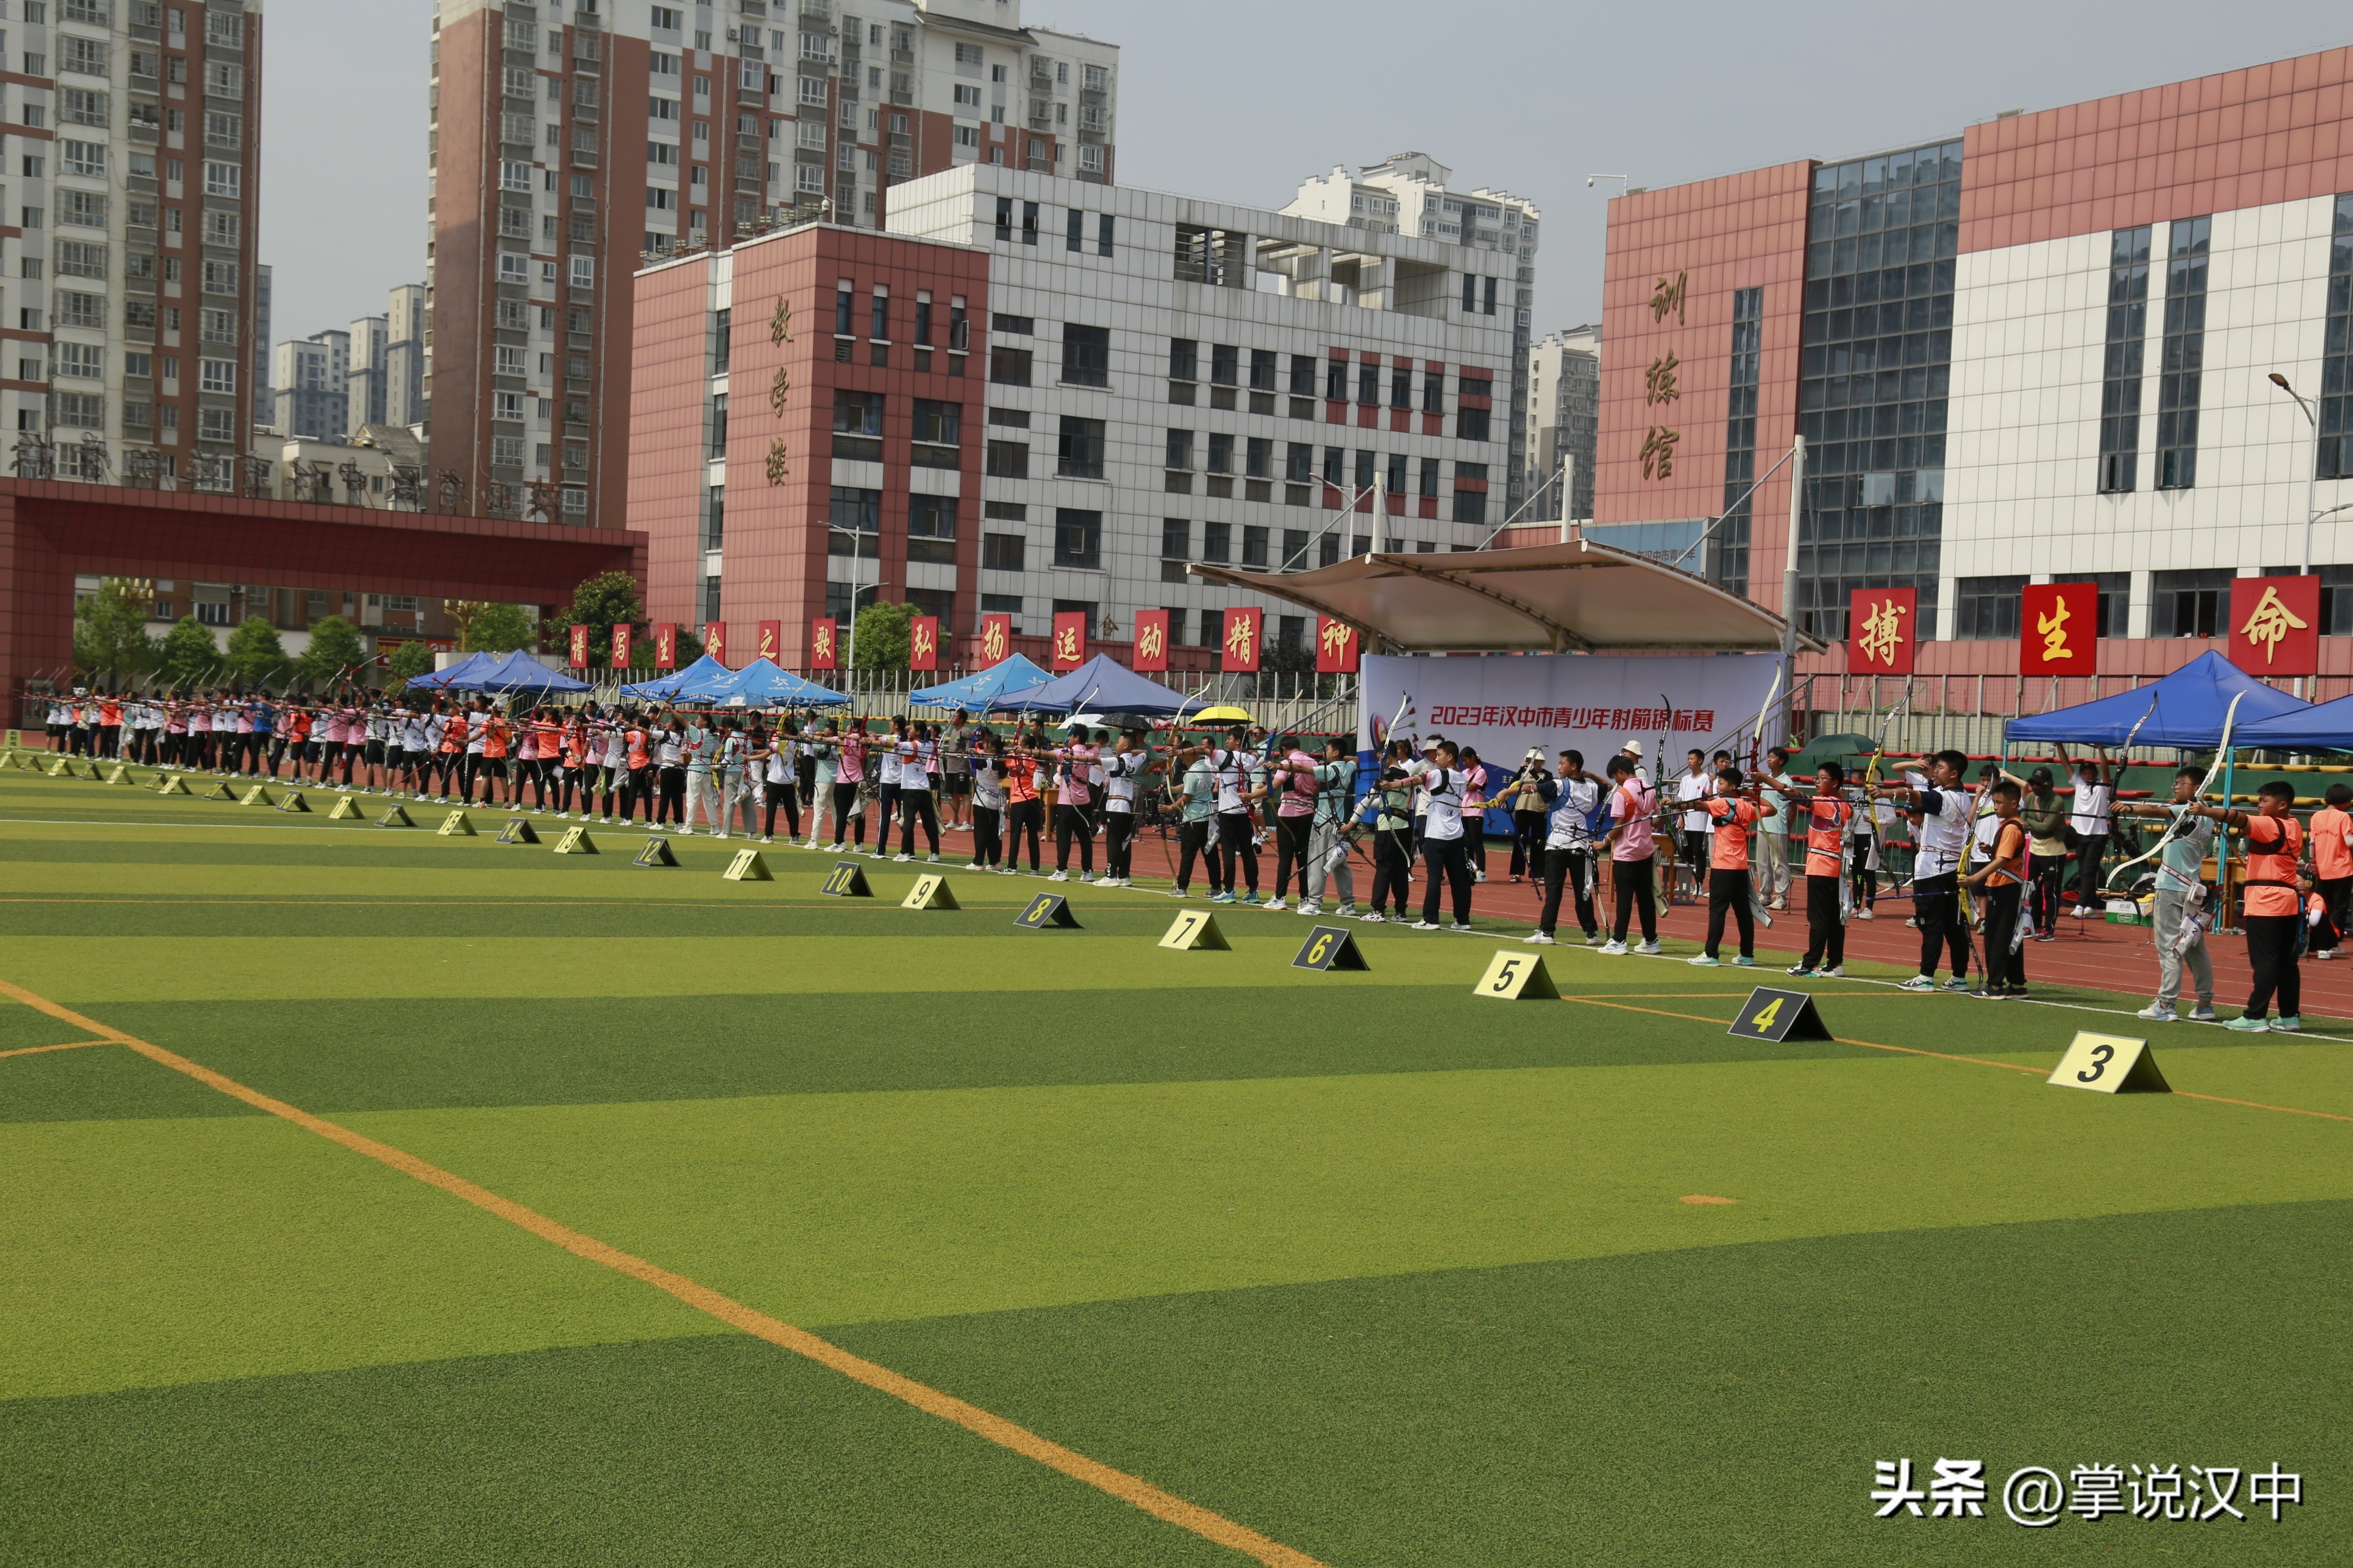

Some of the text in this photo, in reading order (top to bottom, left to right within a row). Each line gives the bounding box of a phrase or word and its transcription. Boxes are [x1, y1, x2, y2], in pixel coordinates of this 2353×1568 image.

[1638, 268, 1688, 481] 训练馆
[765, 295, 794, 487] 教学楼
[914, 624, 932, 661] 弘
[983, 621, 1004, 661] 扬
[1056, 626, 1081, 661] 运
[1139, 622, 1162, 661] 动
[1226, 613, 1254, 664] 精
[1322, 618, 1352, 666] 神
[1859, 586, 2308, 667] 搏 生 命
[571, 626, 831, 664] 谱 写 生 命 之 歌
[1430, 705, 1715, 732] 2023年汉中市青少年射箭锦标赛
[282, 794, 297, 809] 18
[380, 806, 398, 824] 16
[443, 813, 459, 832] 15
[502, 820, 520, 839] 14
[557, 829, 578, 851] 13
[639, 841, 661, 863] 12
[727, 854, 752, 876] 11
[827, 867, 853, 893] 10
[912, 880, 931, 905] 9
[1027, 898, 1052, 923] 8
[1172, 917, 1196, 943] 7
[1307, 933, 1333, 965] 6
[1493, 959, 1521, 993] 5
[1751, 997, 1784, 1033] 4
[2076, 1044, 2115, 1083] 3
